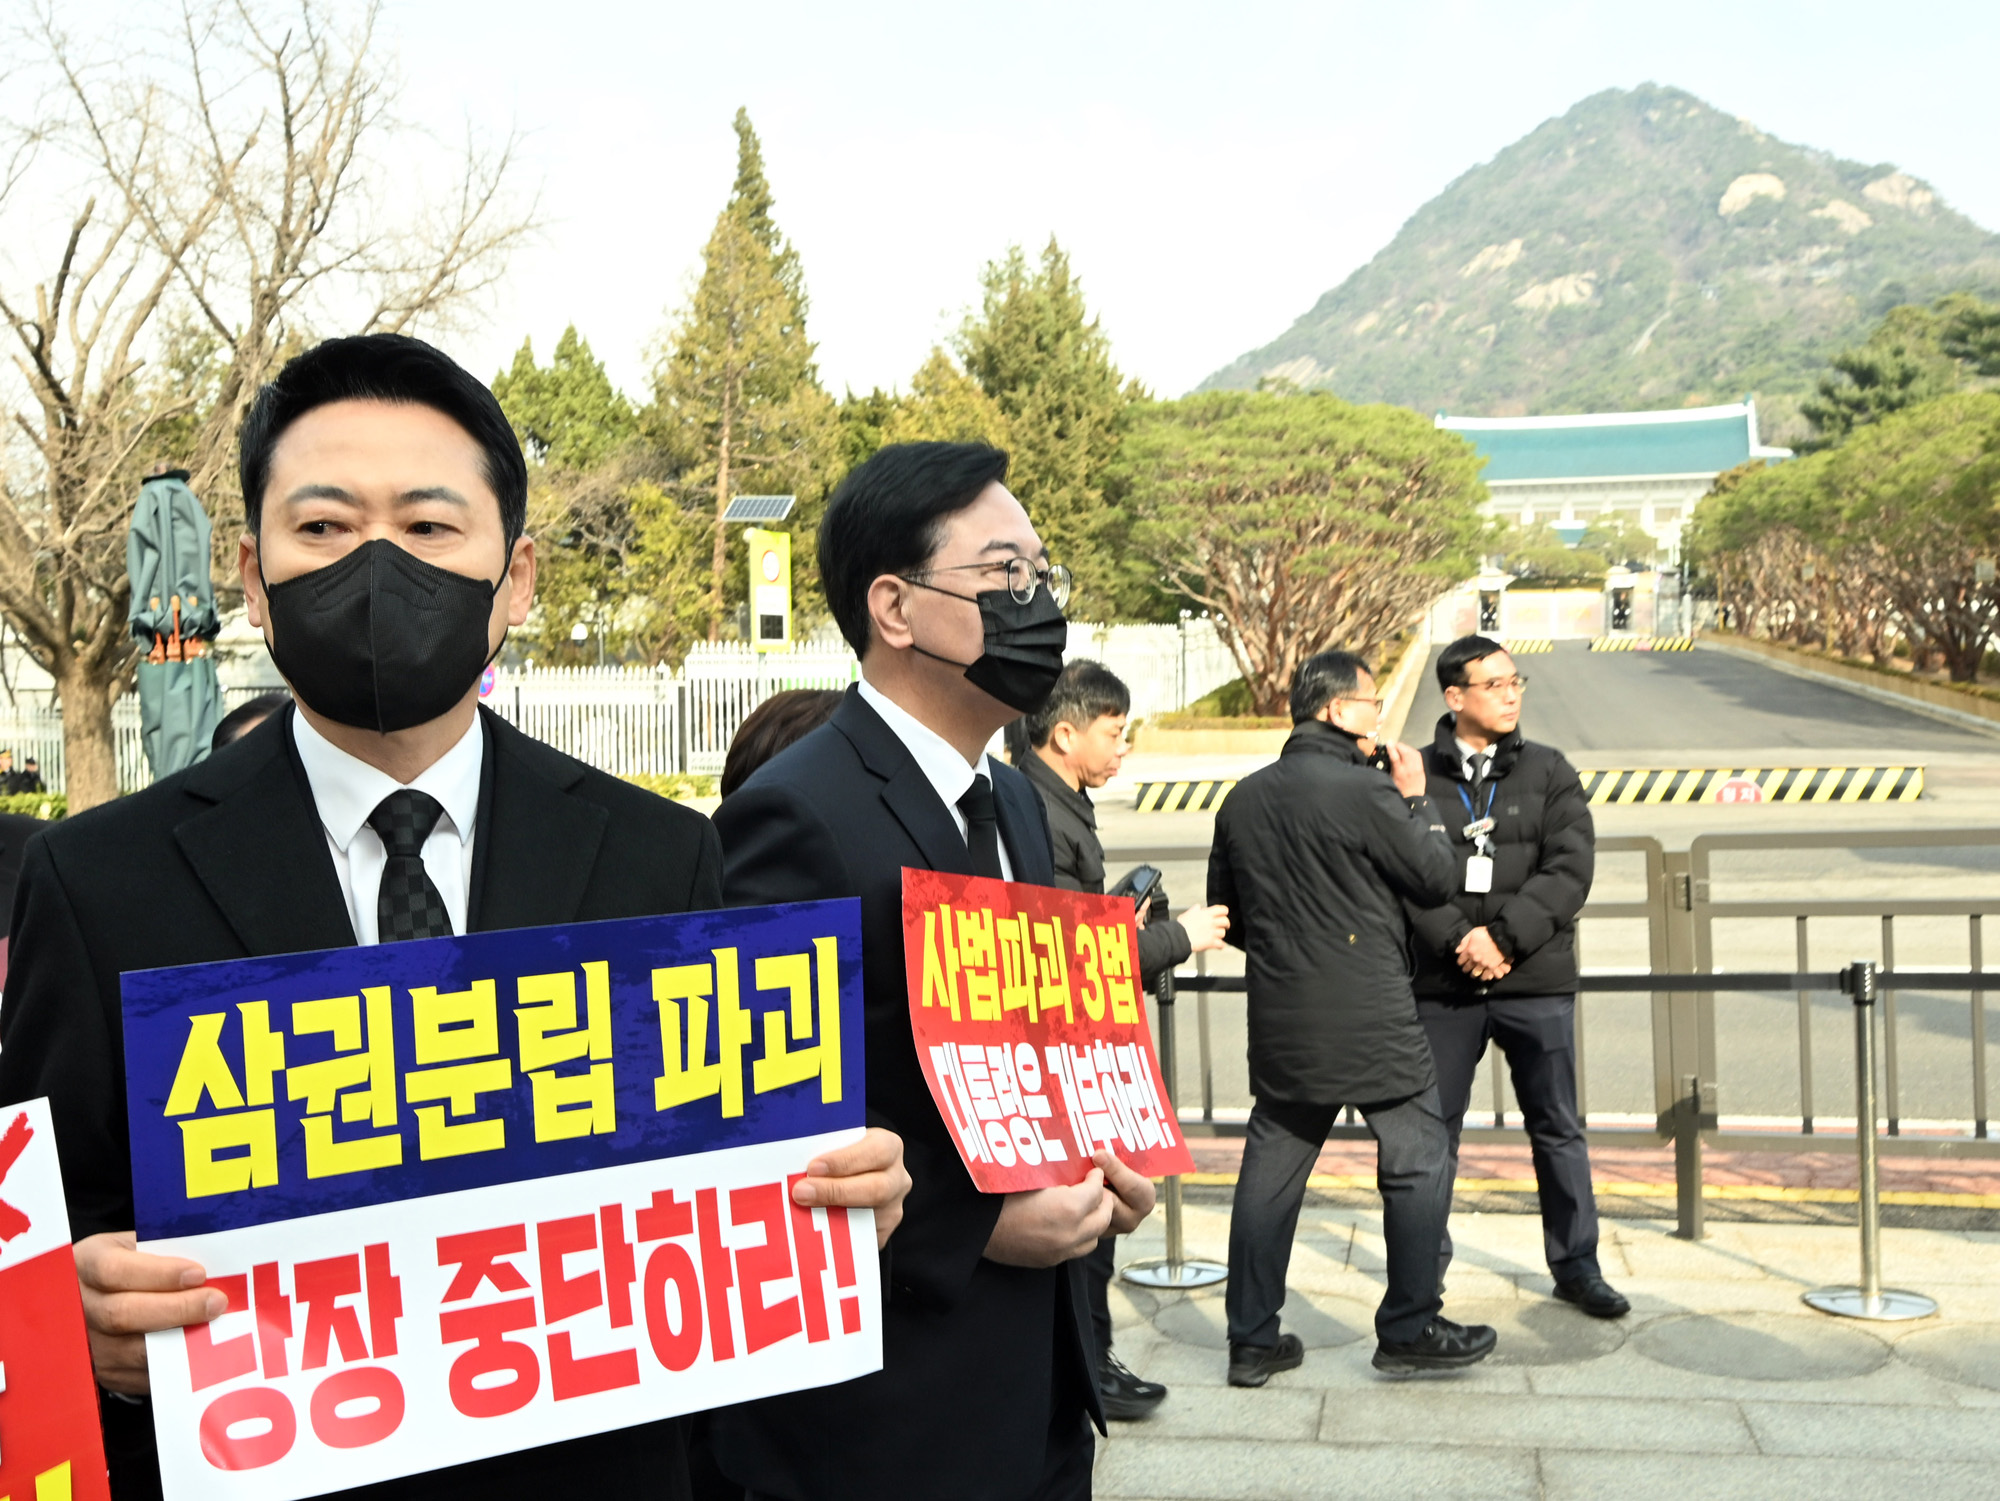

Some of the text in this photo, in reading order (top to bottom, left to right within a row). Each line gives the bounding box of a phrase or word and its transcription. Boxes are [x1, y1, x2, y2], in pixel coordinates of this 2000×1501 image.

[922, 904, 1141, 1024] 사법파괴 3법
[164, 936, 842, 1198] 삼권분립 파괴
[929, 1039, 1176, 1168] 대통령은 거부하라!
[183, 1173, 862, 1471] 당장 중단하라!
